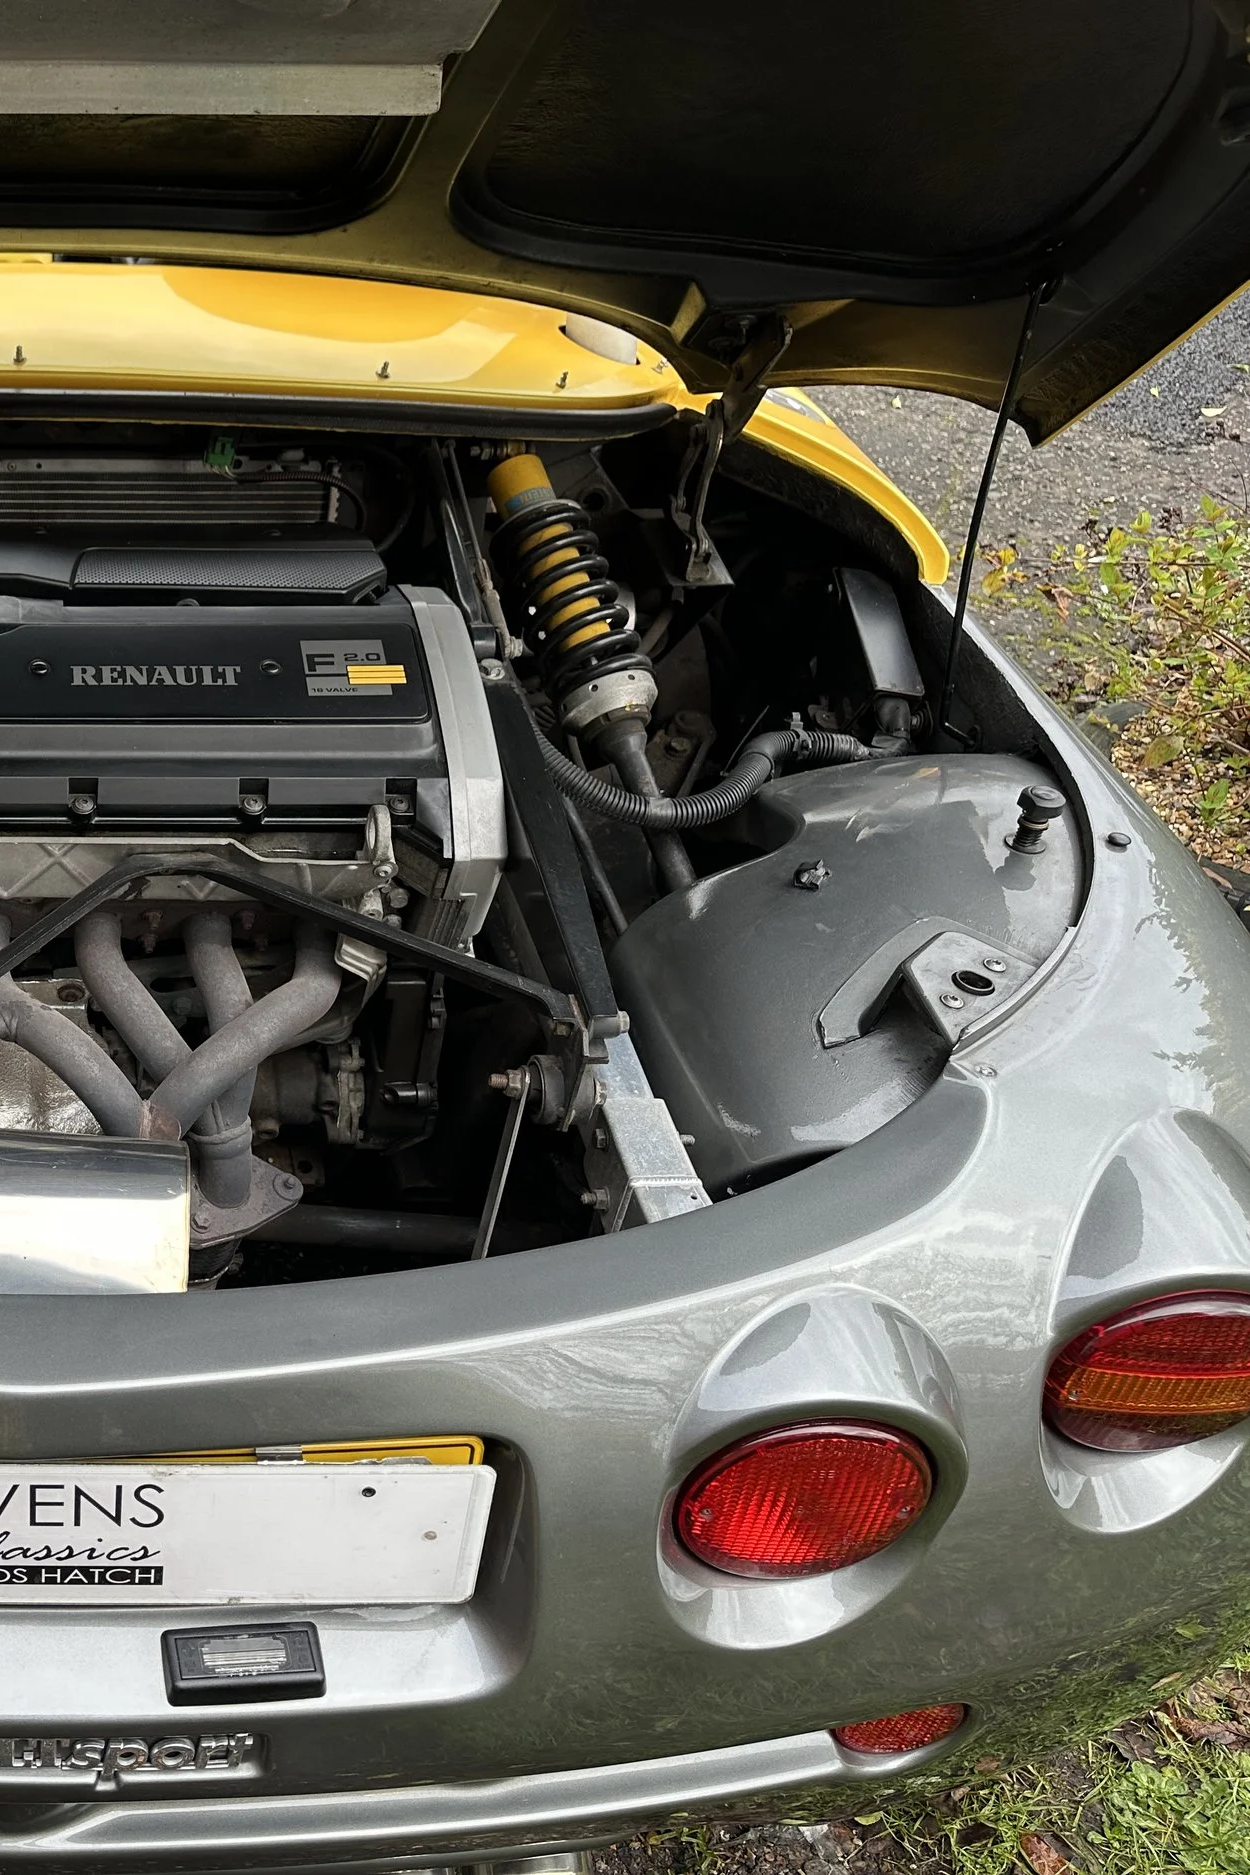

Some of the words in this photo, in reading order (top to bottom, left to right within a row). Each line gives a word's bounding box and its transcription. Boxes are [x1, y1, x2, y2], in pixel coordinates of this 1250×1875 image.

[306, 653, 335, 672] F
[343, 652, 381, 662] 2.0
[69, 665, 242, 687] RENAULT
[41, 1567, 155, 1584] HATCH
